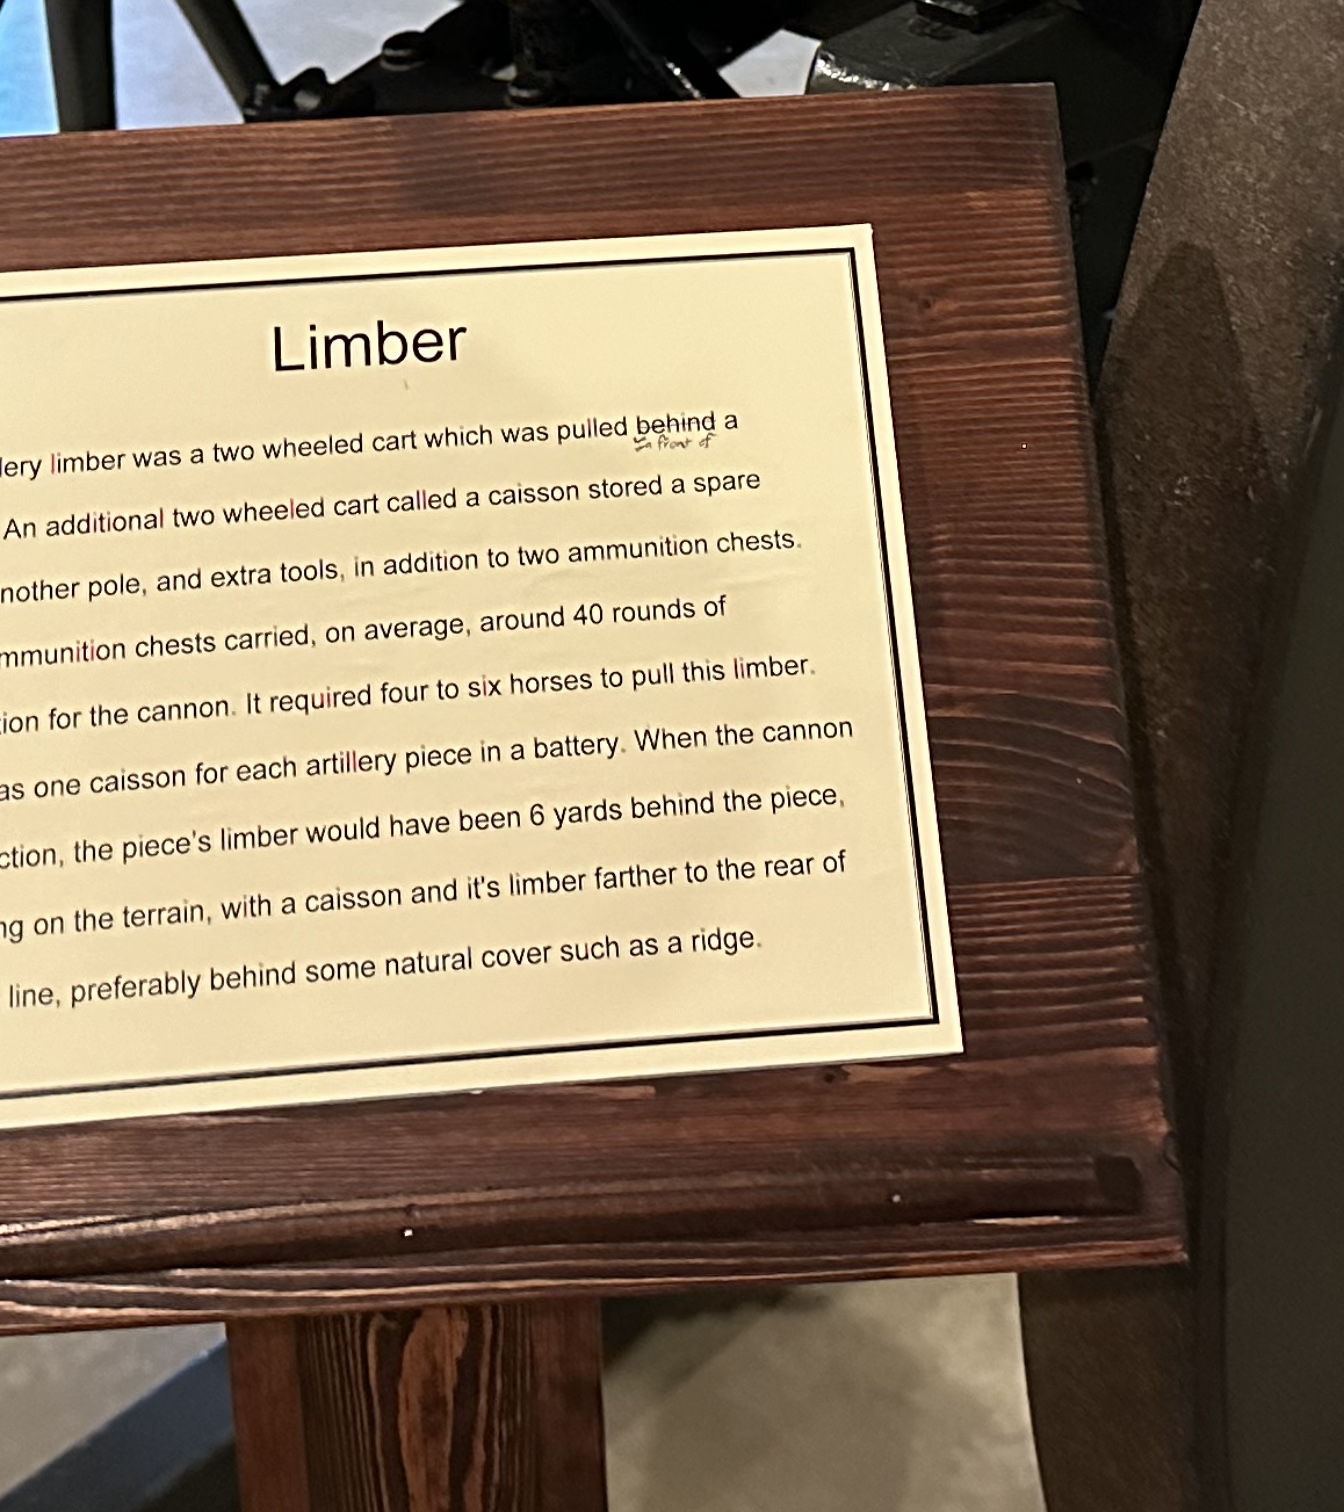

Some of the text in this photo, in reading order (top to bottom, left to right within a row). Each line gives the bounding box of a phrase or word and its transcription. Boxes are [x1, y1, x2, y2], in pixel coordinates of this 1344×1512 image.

[273, 319, 468, 373] Limber
[50, 450, 127, 475] limber
[131, 449, 182, 469] was
[189, 447, 204, 465] a
[212, 442, 255, 464] two
[261, 431, 364, 460] wheeled
[371, 429, 418, 453] cart
[423, 424, 493, 449] which
[499, 425, 550, 444] was
[557, 415, 628, 446] pulled
[635, 409, 717, 436] behind
[724, 413, 739, 431] a
[2, 517, 37, 541] An
[45, 506, 164, 538] additional
[172, 507, 216, 529] two
[222, 496, 325, 525] wheeled
[333, 492, 381, 517] cart
[386, 486, 457, 513] called
[465, 491, 481, 508] a
[487, 482, 580, 506] caisson
[587, 473, 663, 500] stored
[671, 477, 686, 495] a
[693, 473, 761, 498] spare
[88, 572, 147, 603] pole,
[156, 567, 202, 592] and
[210, 564, 272, 588] extra
[279, 558, 345, 584] tools,
[354, 555, 375, 578] in
[383, 550, 479, 576] addition
[486, 547, 510, 569] to
[517, 545, 560, 567] two
[567, 534, 709, 563] ammunition
[716, 529, 802, 554] chests.
[135, 632, 217, 658] chests
[224, 622, 317, 652] carried,
[325, 624, 356, 644] on
[364, 617, 471, 642] average,
[479, 604, 565, 633] around
[572, 602, 604, 626] 40
[612, 597, 696, 624] rounds
[703, 593, 727, 618] of
[48, 706, 83, 731] for
[88, 703, 129, 728] the
[137, 699, 237, 724] cannon.
[246, 692, 262, 715] It
[269, 682, 372, 717] required
[379, 681, 430, 705] four
[435, 679, 460, 701] to
[467, 674, 503, 699] six
[509, 672, 593, 695] horses
[599, 667, 624, 689] to
[631, 661, 675, 693] pull
[681, 658, 726, 684] this
[733, 654, 816, 680] limber.
[33, 777, 81, 799] one
[89, 768, 186, 794] caisson
[195, 761, 230, 786] for
[236, 755, 297, 782] each
[305, 749, 397, 777] artillery
[405, 744, 472, 775] piece
[480, 739, 501, 763] in
[510, 743, 526, 761] a
[533, 734, 627, 760] battery.
[633, 727, 708, 752] When
[714, 723, 755, 747] the
[762, 720, 853, 743] cannon
[73, 838, 114, 864] the
[122, 829, 212, 866] piece's
[220, 824, 299, 852] limber
[305, 814, 381, 845] would
[389, 813, 451, 838] have
[458, 808, 521, 832] been
[529, 802, 545, 827] 6
[552, 797, 623, 831] yards
[630, 790, 715, 819] behind
[722, 788, 763, 813] the
[770, 785, 845, 816] piece,
[33, 915, 65, 936] on
[73, 907, 115, 933] the
[122, 898, 212, 929] terrain,
[220, 892, 272, 920] with
[281, 896, 297, 916] a
[304, 886, 402, 913] caisson
[411, 877, 458, 905] and
[467, 875, 501, 901] it's
[508, 869, 587, 897] limber
[593, 863, 678, 890] farther
[683, 860, 709, 884] to
[715, 856, 756, 882] the
[764, 856, 816, 879] rear
[822, 848, 847, 874] of
[9, 983, 61, 1009] line,
[71, 968, 202, 1010] preferably
[209, 959, 296, 992] behind
[305, 959, 376, 984] some
[385, 945, 473, 977] natural
[481, 944, 553, 969] cover
[559, 934, 620, 963] such
[629, 937, 659, 957] as
[667, 935, 683, 955] a
[691, 926, 762, 957] ridge.
